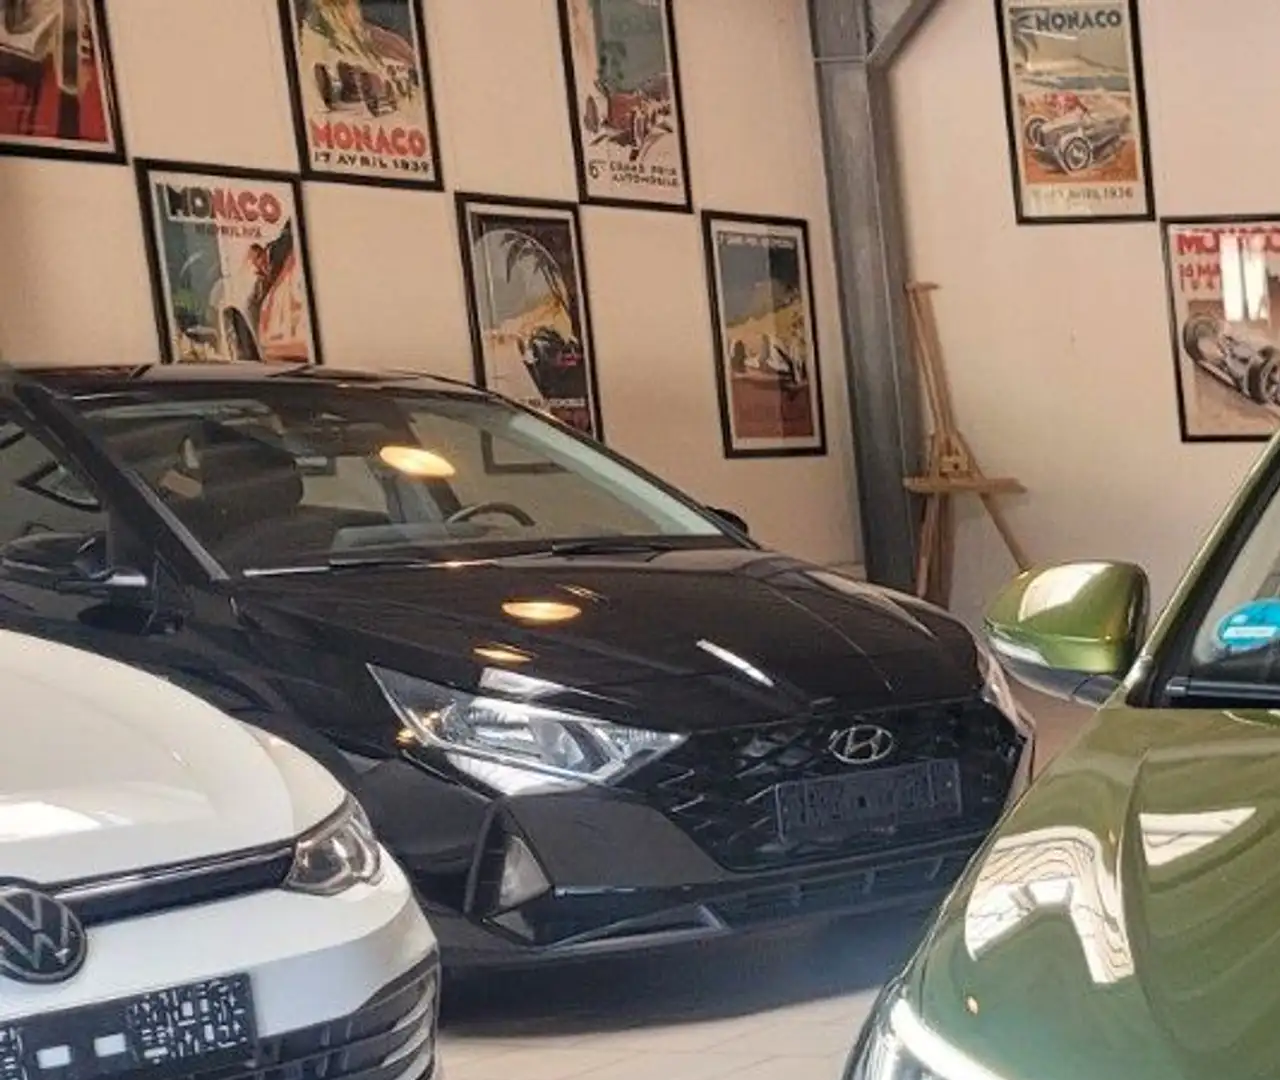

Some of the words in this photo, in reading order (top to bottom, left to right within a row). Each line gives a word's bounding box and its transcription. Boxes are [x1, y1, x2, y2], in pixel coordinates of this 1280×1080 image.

[310, 119, 426, 157] MONACO
[337, 155, 387, 169] AVRIL
[156, 183, 282, 224] MONACO
